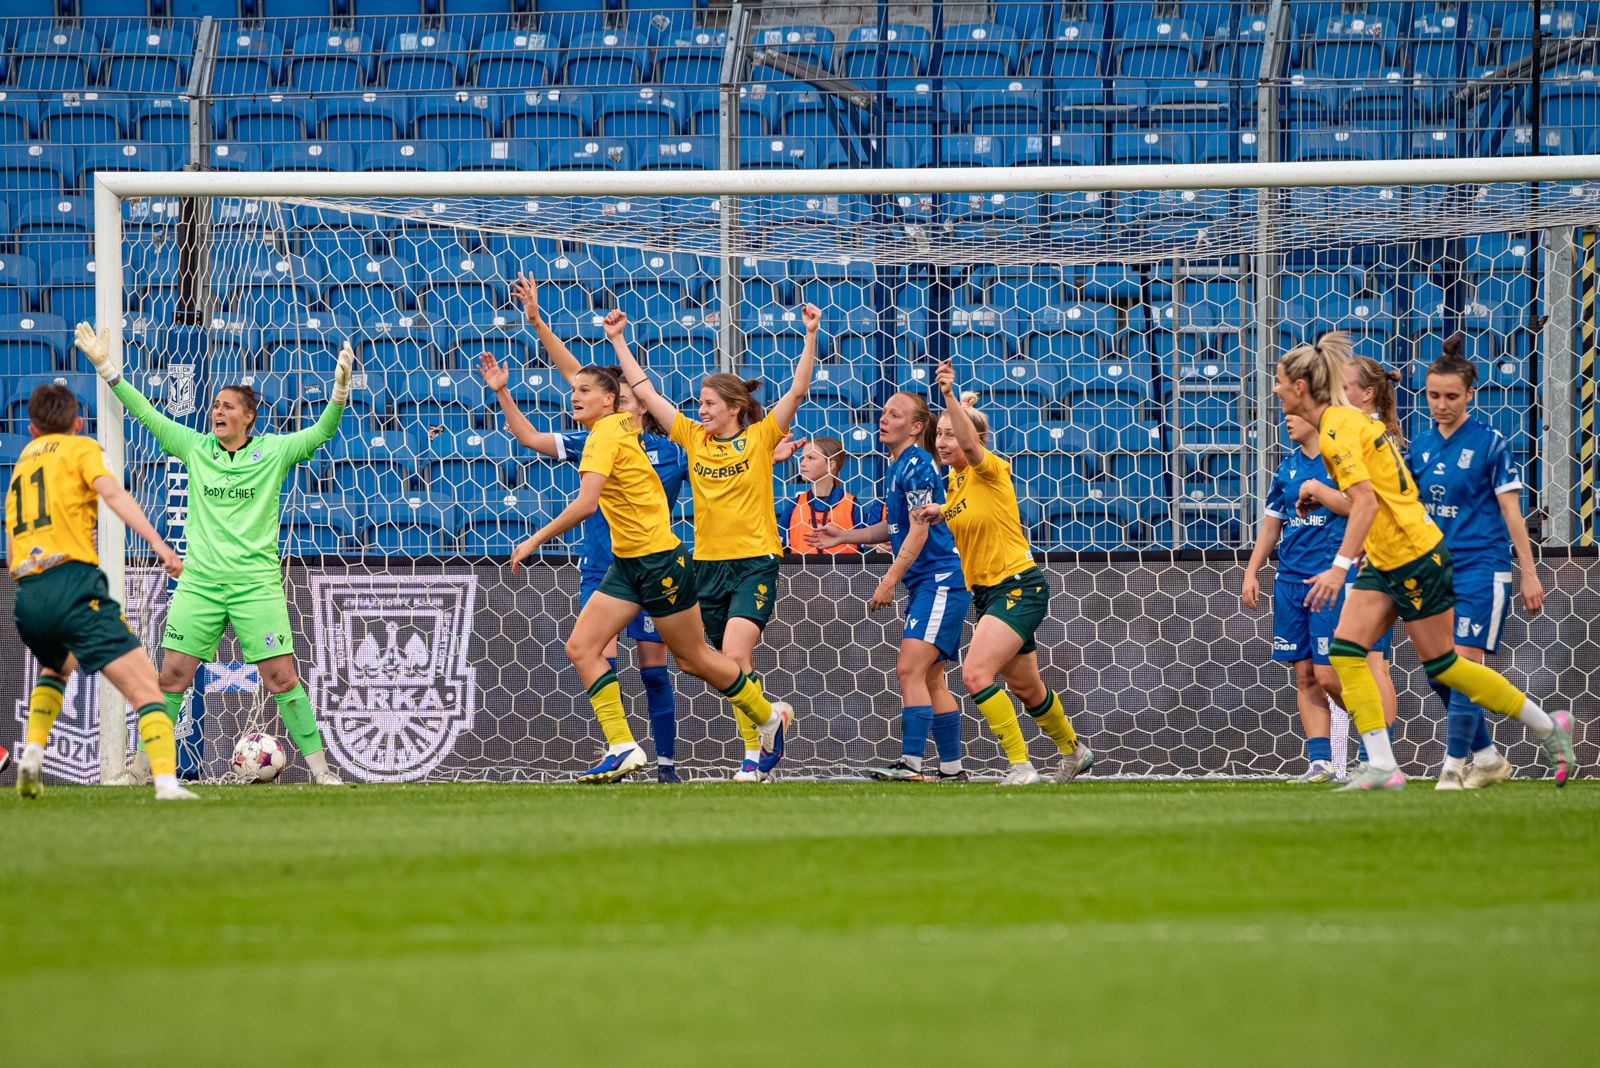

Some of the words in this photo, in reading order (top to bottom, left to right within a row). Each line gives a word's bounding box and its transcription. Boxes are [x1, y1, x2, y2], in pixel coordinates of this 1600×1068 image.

[694, 459, 750, 479] SUPERBET
[11, 466, 52, 537] 11
[203, 485, 226, 499] BODY
[228, 487, 256, 499] CHIEF
[945, 498, 968, 522] ERBET
[341, 687, 445, 711] ARKA
[45, 733, 100, 764] POZN
